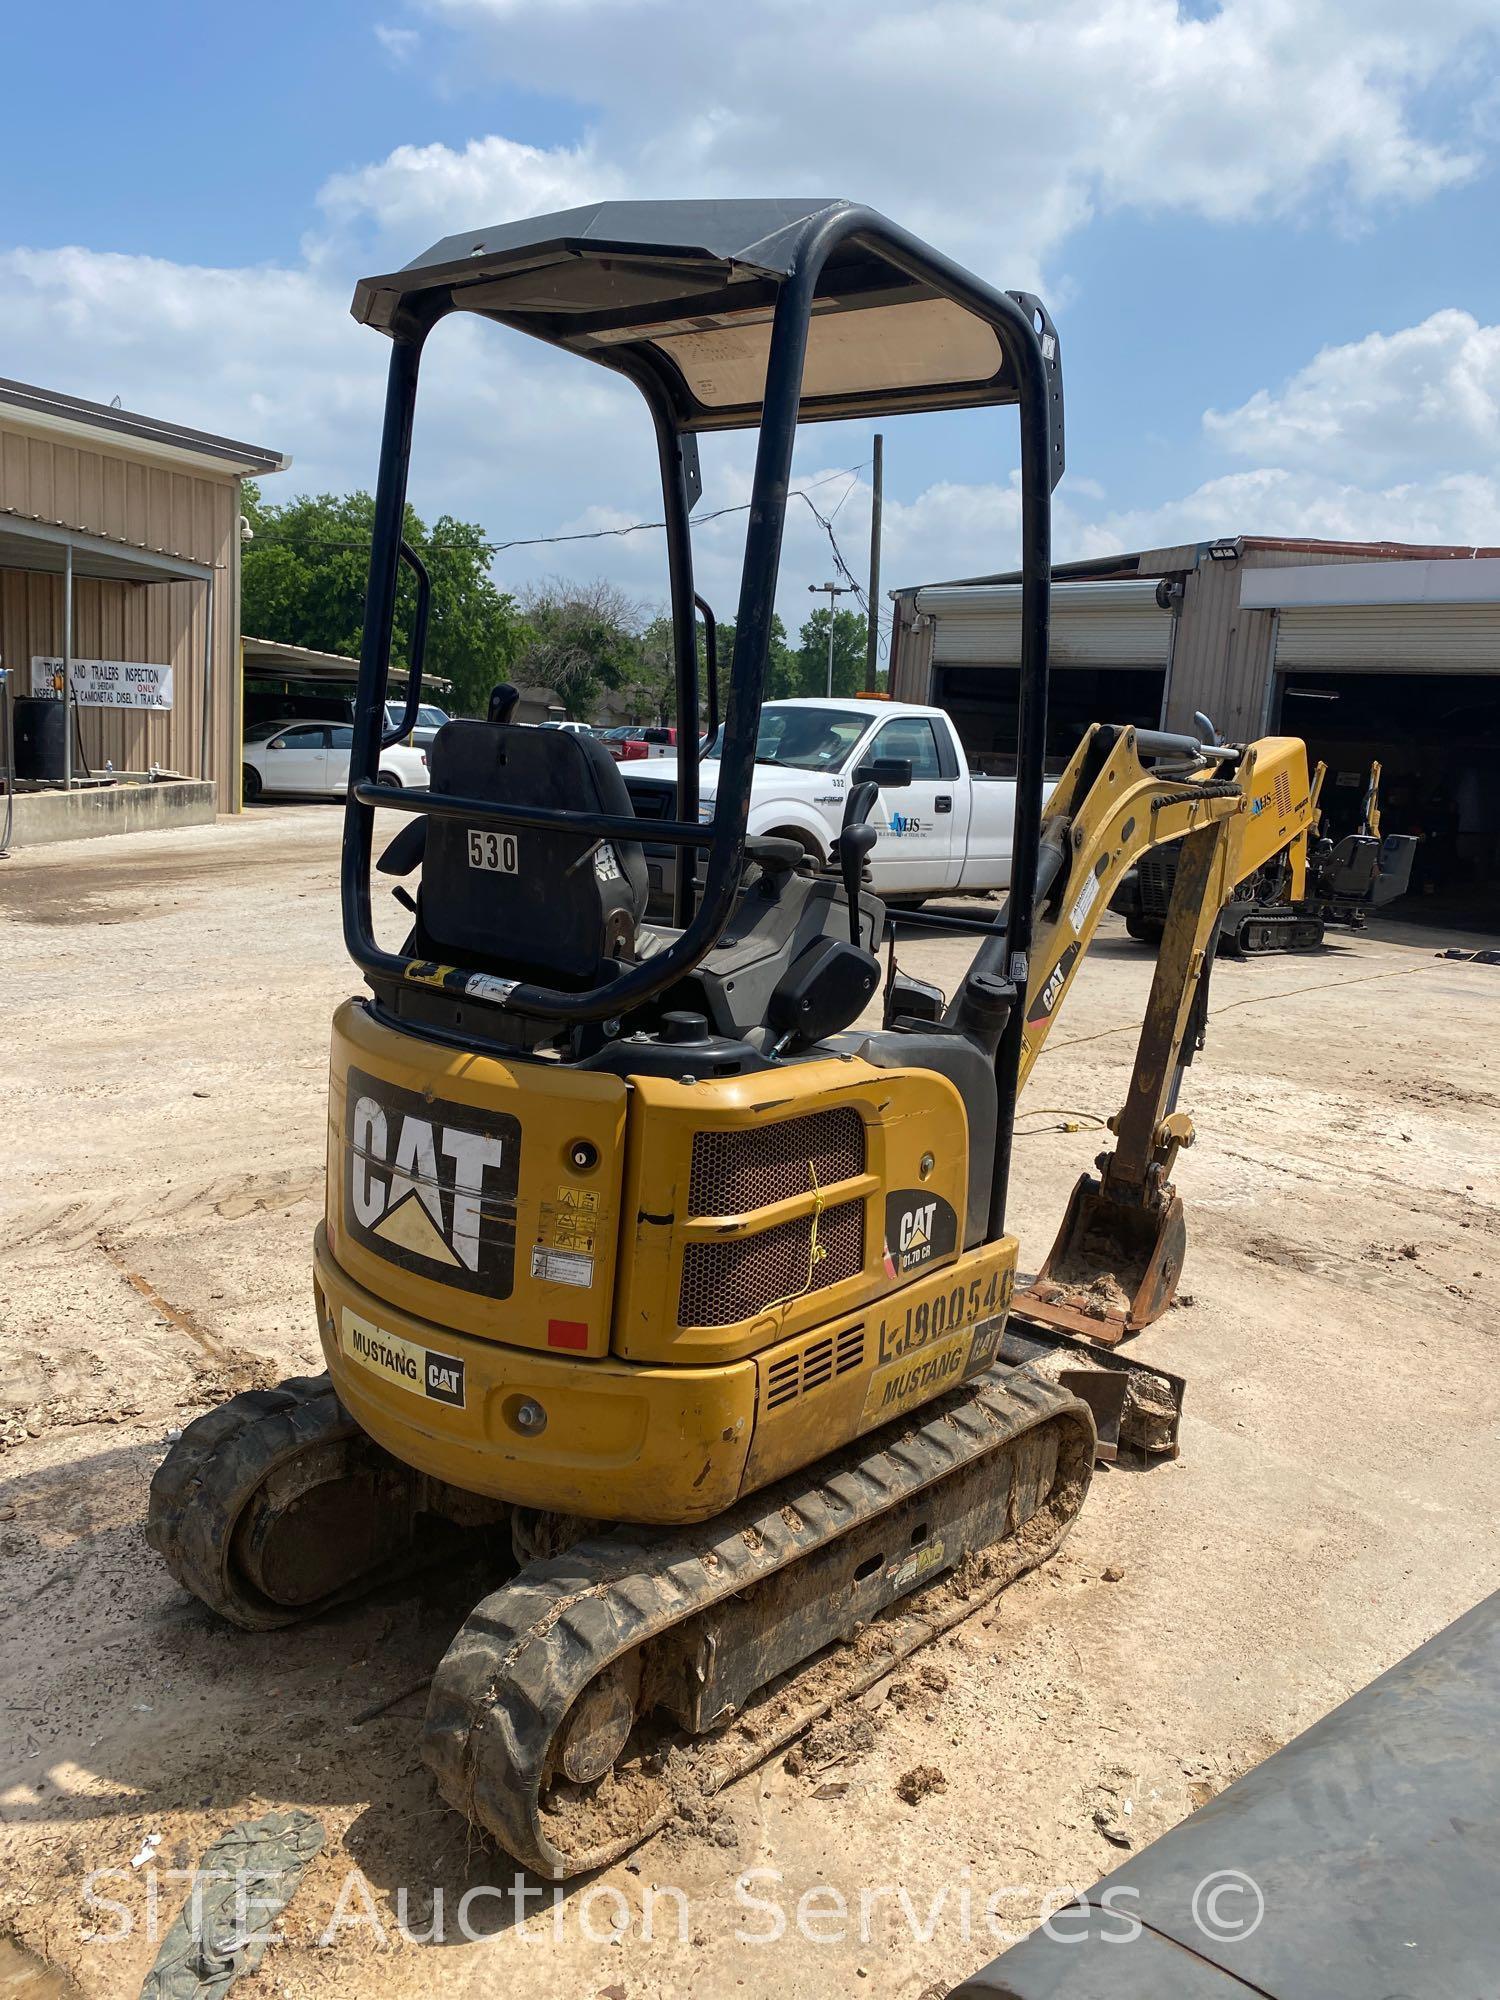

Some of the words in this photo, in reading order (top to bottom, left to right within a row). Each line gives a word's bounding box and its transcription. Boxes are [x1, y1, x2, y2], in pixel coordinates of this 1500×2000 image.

[74, 665, 85, 679] AND
[91, 666, 119, 681] TRAILERS
[125, 668, 159, 684] INSPECTION
[137, 684, 156, 693] ONLY
[81, 690, 113, 704] CAMIONETAS
[116, 692, 133, 704] DISEL
[140, 693, 163, 706] TRAILAS
[832, 779, 844, 787] 332
[896, 816, 920, 832] MJS
[471, 833, 516, 871] 530
[1042, 962, 1065, 1012] CAT
[353, 1096, 502, 1272] CAT
[900, 1203, 937, 1252] CAT
[921, 1245, 931, 1259] CR
[353, 1329, 416, 1380] MUSTANG
[428, 1364, 459, 1394] CAT
[881, 1347, 963, 1407] MUSTANG
